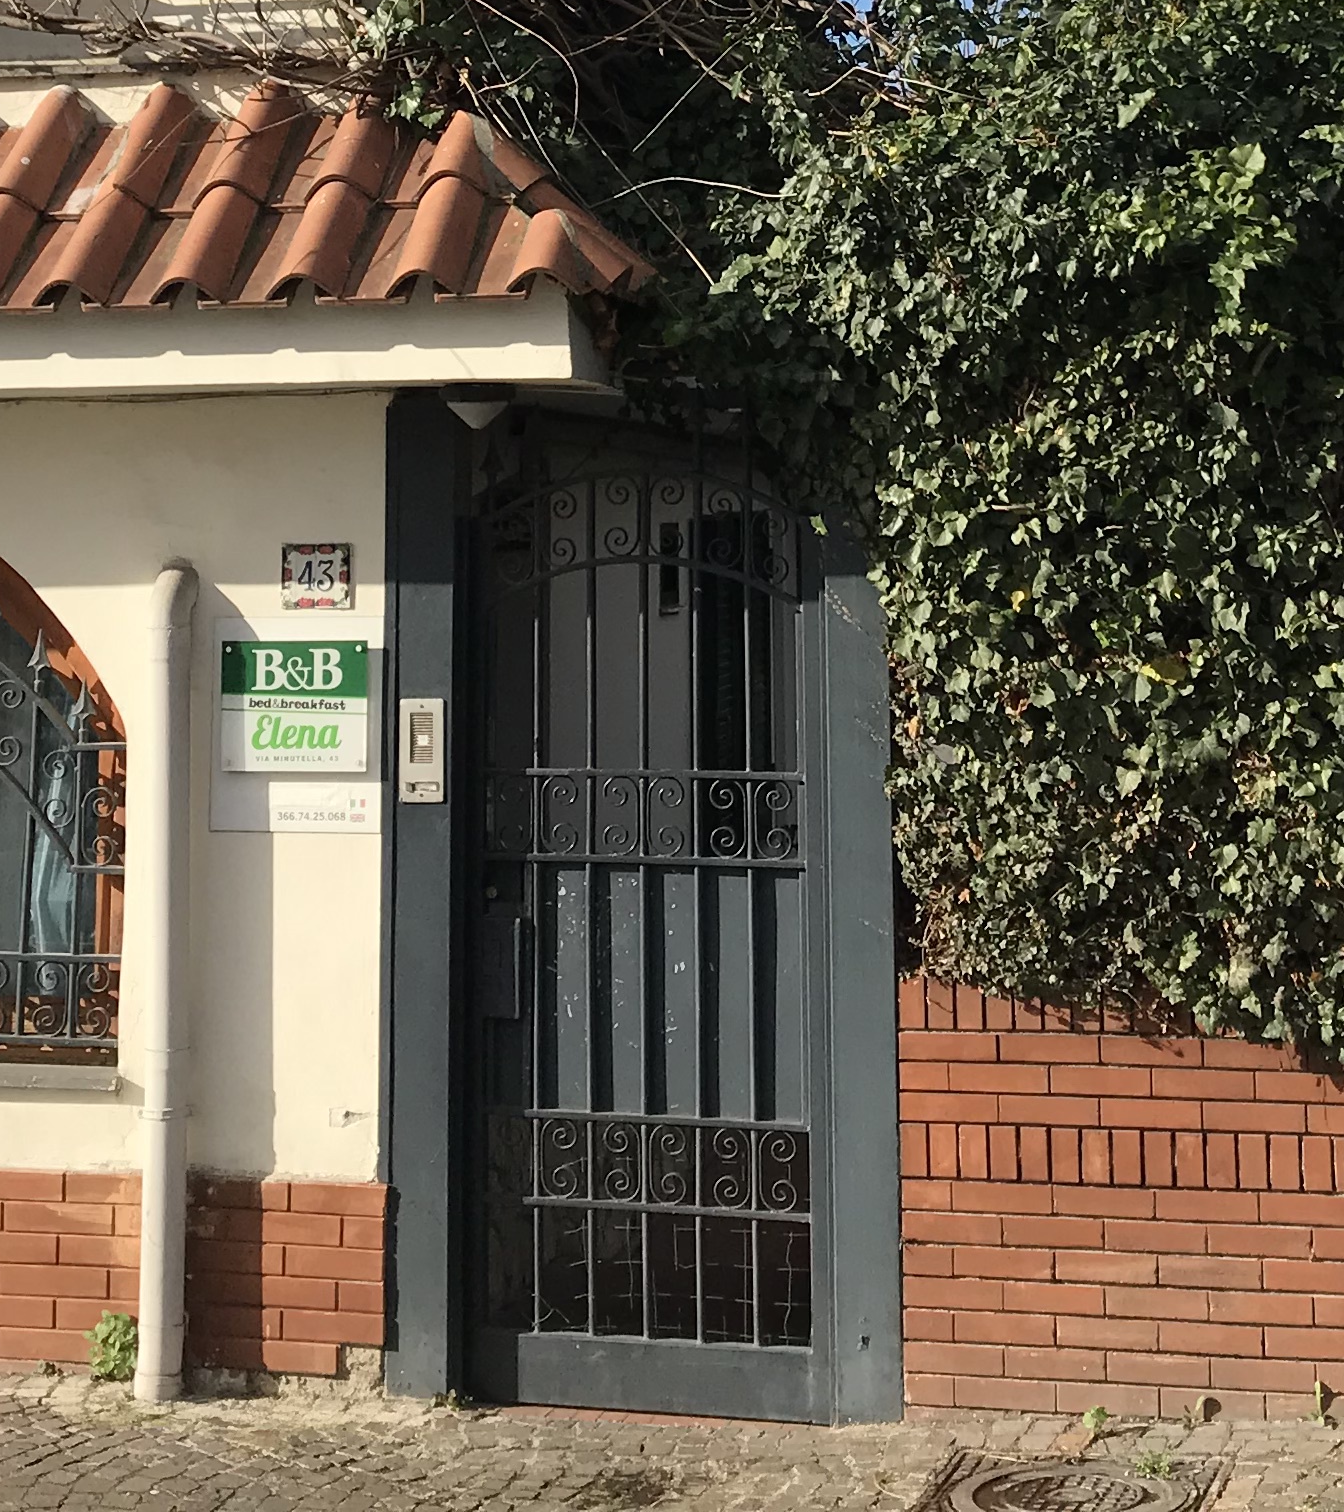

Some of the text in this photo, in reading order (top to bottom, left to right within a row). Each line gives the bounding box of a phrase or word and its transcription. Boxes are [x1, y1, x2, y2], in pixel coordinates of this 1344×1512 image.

[297, 559, 334, 592] 43
[251, 648, 344, 691] B&B
[249, 697, 346, 711] bed&breakfast
[251, 714, 342, 750] Elena
[277, 811, 346, 821] 366.74.25.068
